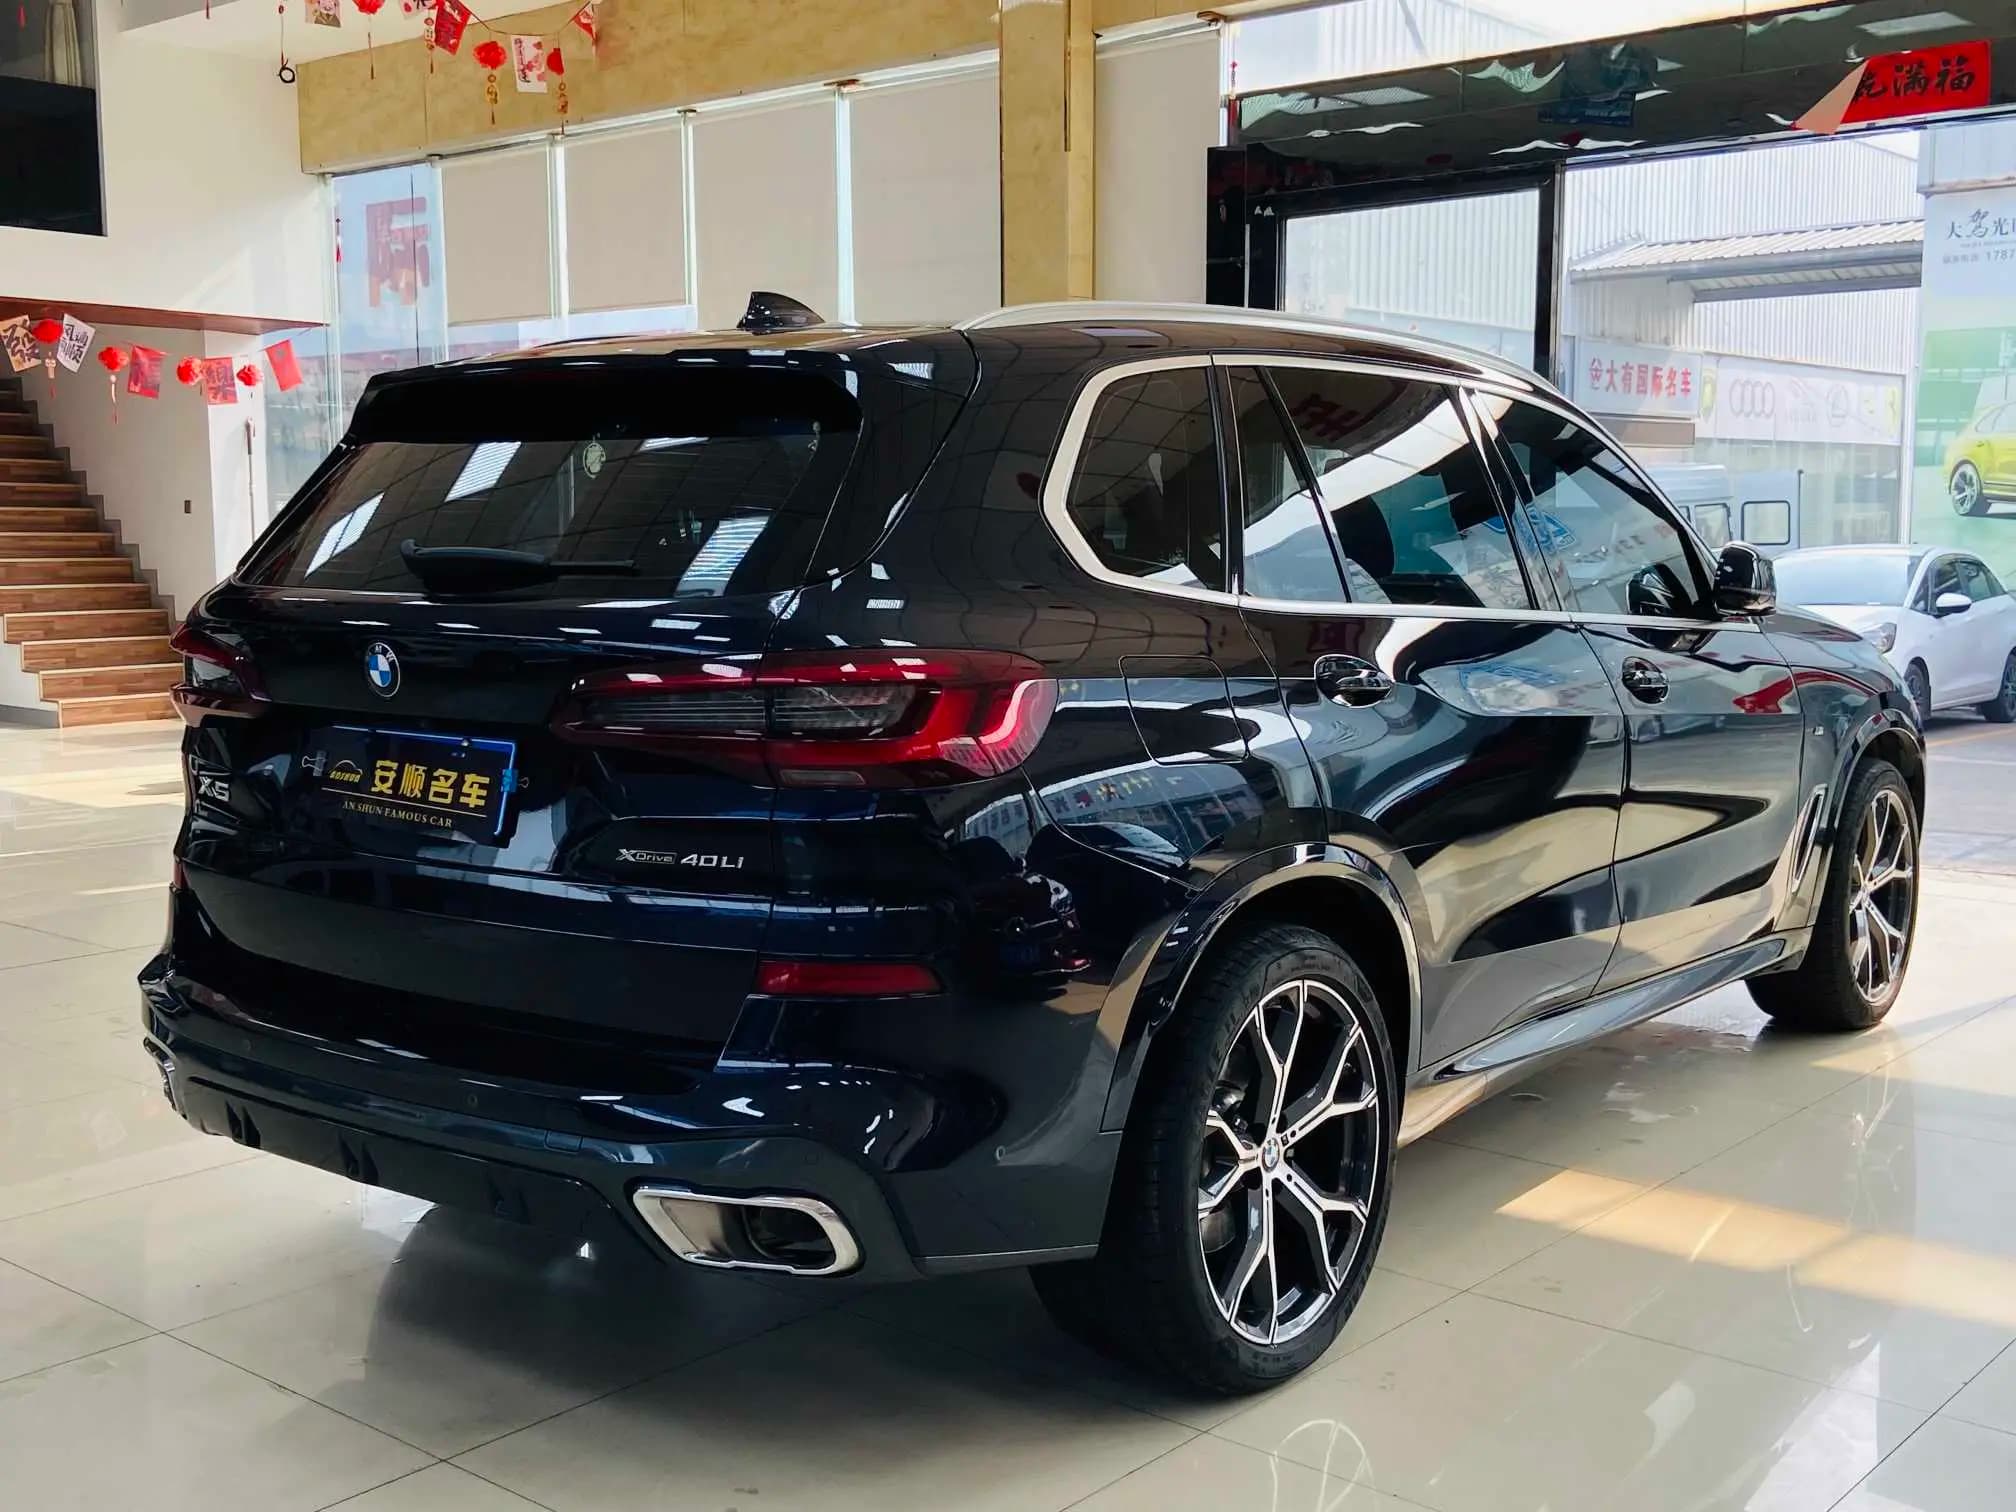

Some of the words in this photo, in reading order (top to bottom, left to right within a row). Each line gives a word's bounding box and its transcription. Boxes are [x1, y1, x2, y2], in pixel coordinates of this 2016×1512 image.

[198, 776, 230, 802] X5
[371, 760, 490, 808] 安顺名车
[342, 800, 355, 810] AN
[357, 802, 383, 815] SHUN
[384, 807, 428, 824] FAMOUS
[429, 815, 453, 828] CAR
